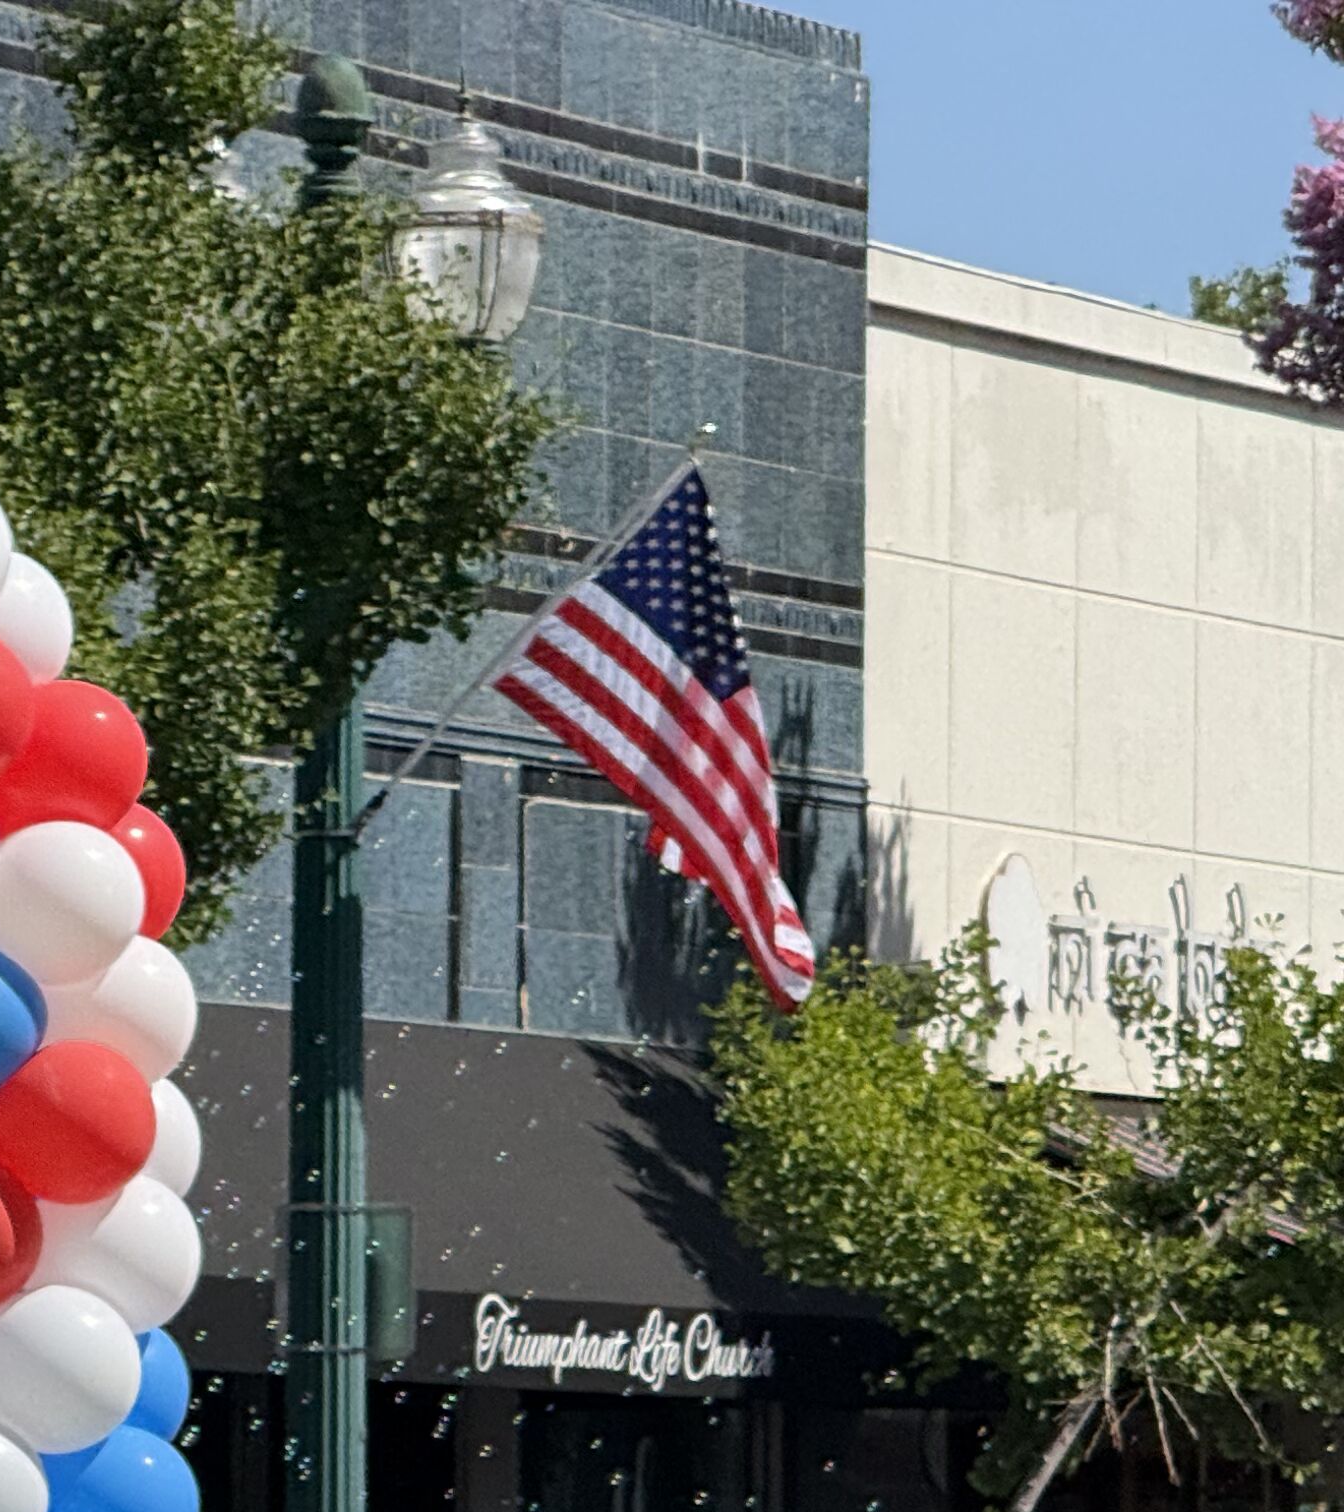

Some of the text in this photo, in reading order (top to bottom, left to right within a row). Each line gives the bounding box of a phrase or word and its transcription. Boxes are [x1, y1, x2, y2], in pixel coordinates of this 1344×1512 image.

[475, 1292, 775, 1392] Triumphant Life Church
